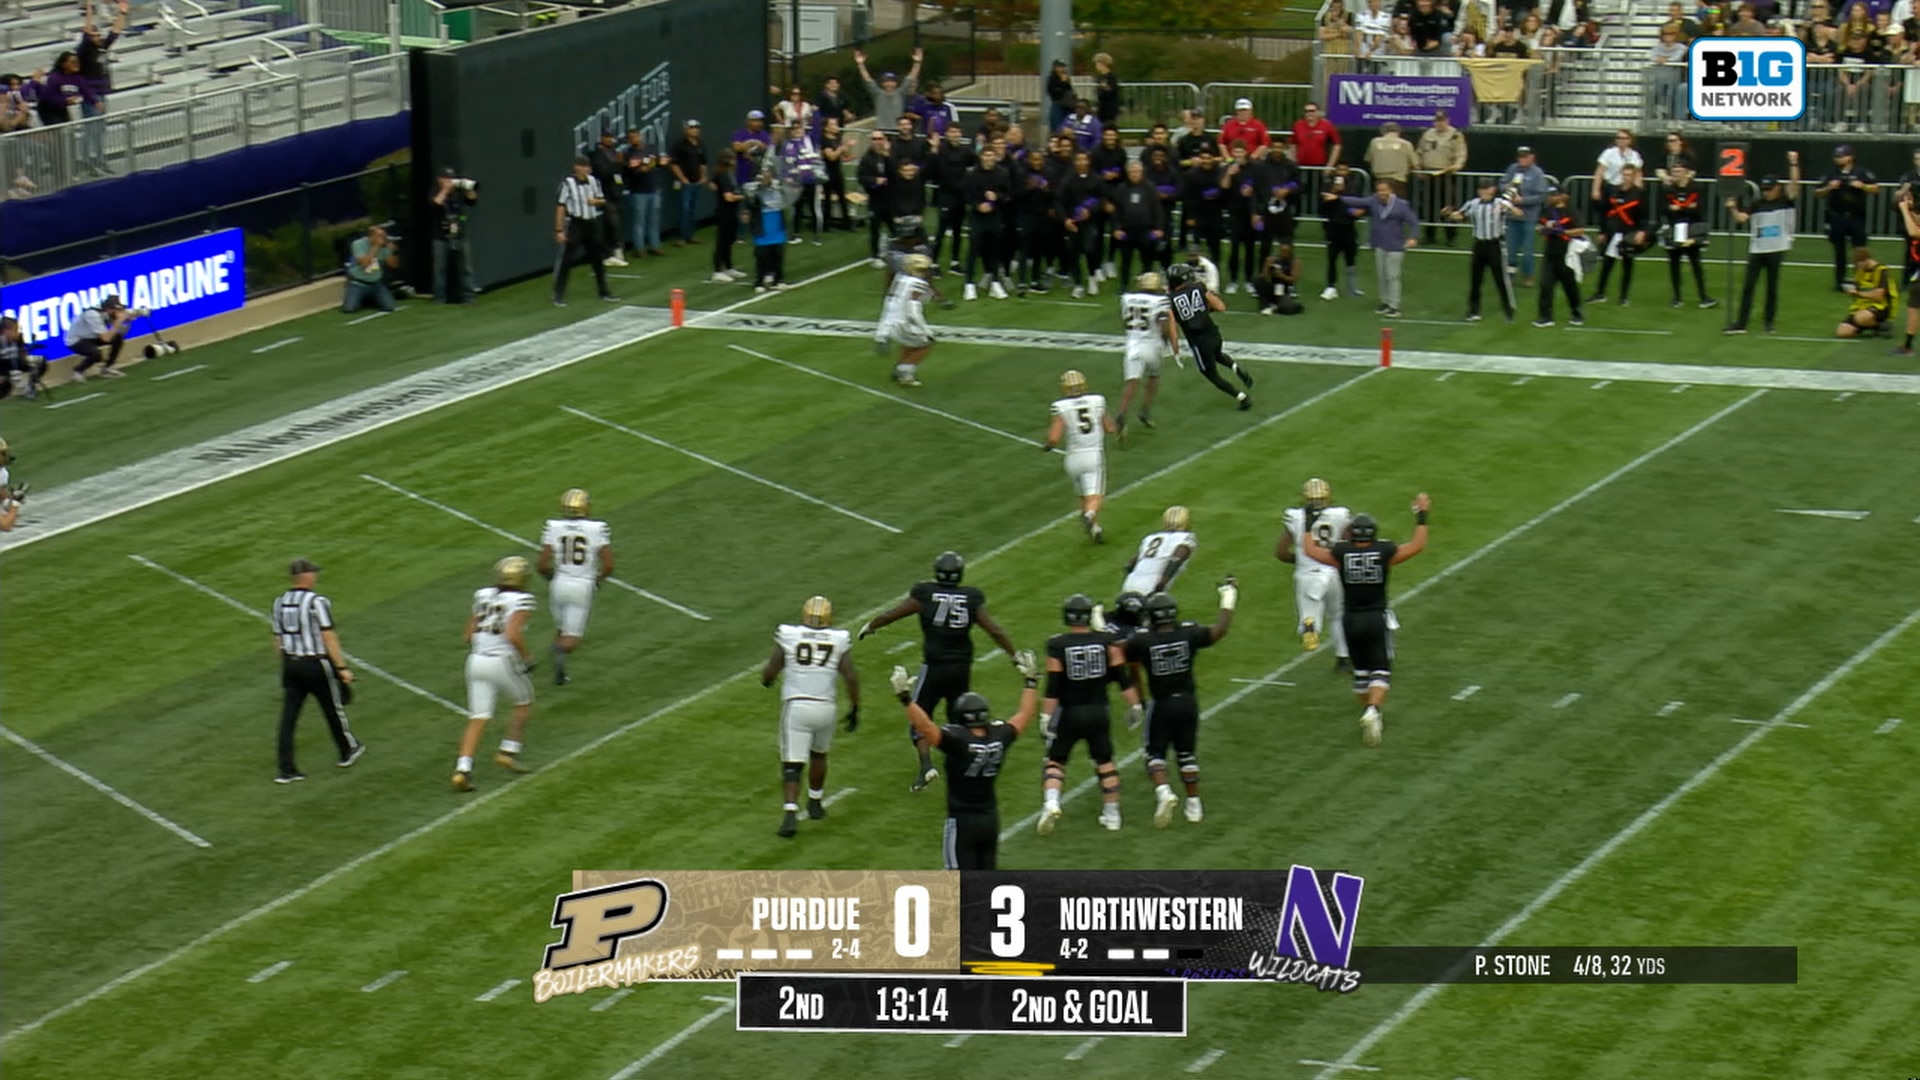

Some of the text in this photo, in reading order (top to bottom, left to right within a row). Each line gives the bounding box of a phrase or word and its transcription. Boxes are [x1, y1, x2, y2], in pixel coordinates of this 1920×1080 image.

[641, 71, 671, 109] FOR
[1375, 82, 1460, 95] Northwestern
[1375, 95, 1457, 107] Medicine Field
[1719, 148, 1746, 177] 2
[0, 280, 129, 346] METOWN
[1173, 289, 1206, 321] 84
[1078, 408, 1093, 435] 5
[559, 535, 587, 566] 16
[931, 592, 970, 628] 75
[796, 642, 834, 666] 97
[1149, 640, 1190, 676] 62
